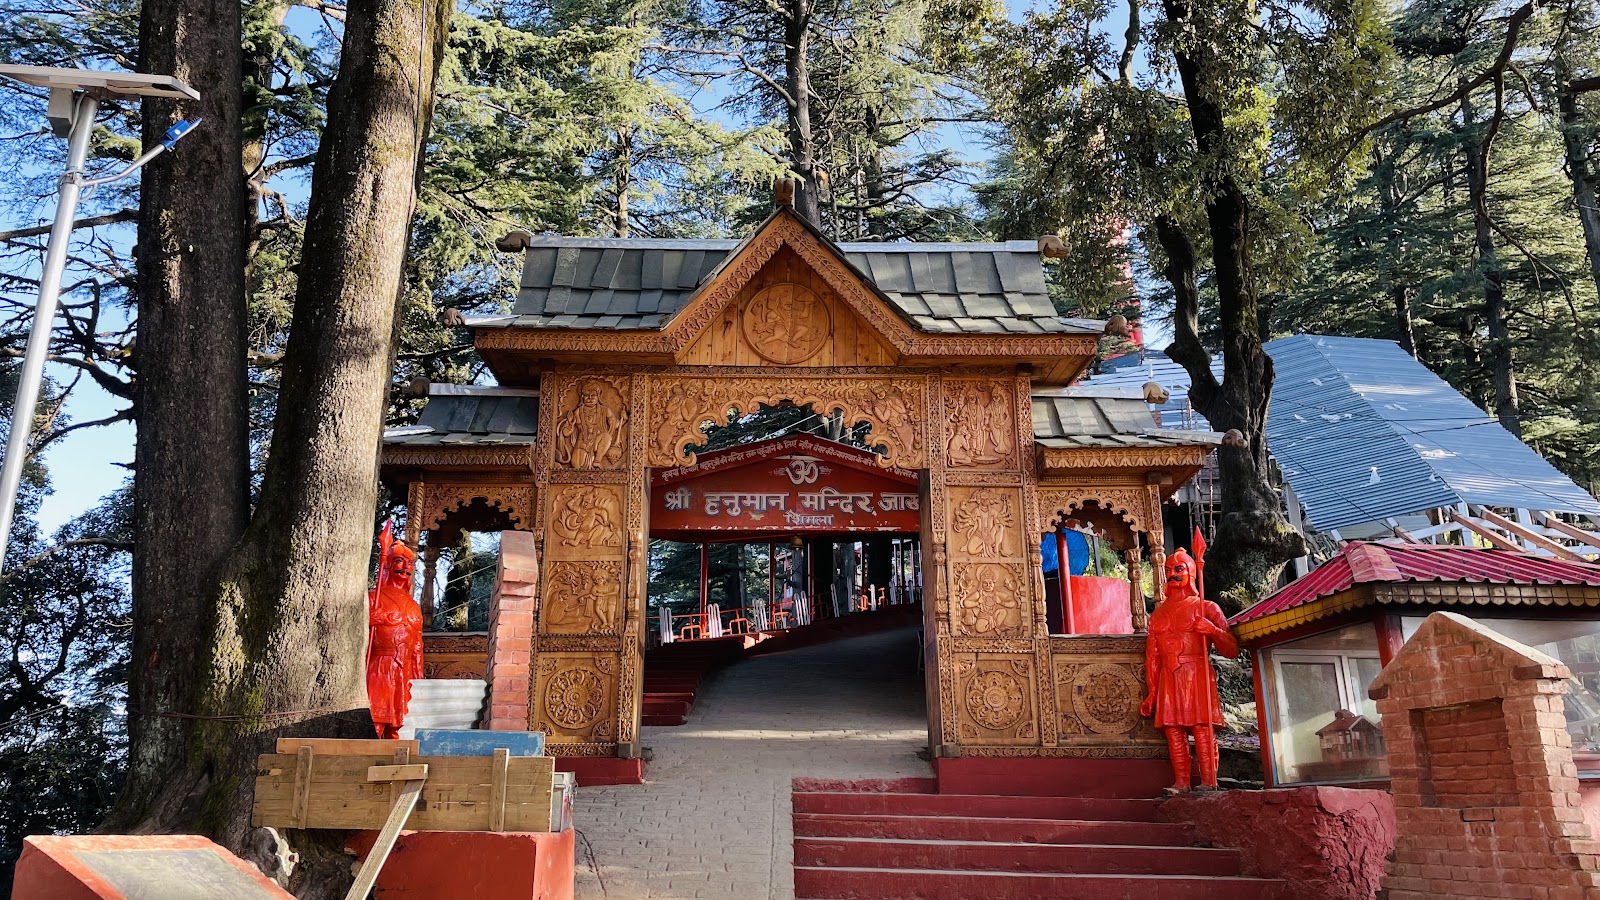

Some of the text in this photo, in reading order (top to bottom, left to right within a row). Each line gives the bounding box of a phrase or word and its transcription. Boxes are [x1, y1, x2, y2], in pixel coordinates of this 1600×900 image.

[662, 468, 679, 481] कृपया
[746, 449, 757, 458] तक
[776, 442, 784, 451] के
[783, 440, 797, 449] लिए
[664, 486, 692, 510] श्री
[703, 492, 790, 516] हनुमान
[797, 486, 876, 513] मन्दिर
[782, 509, 834, 526] शिमला
